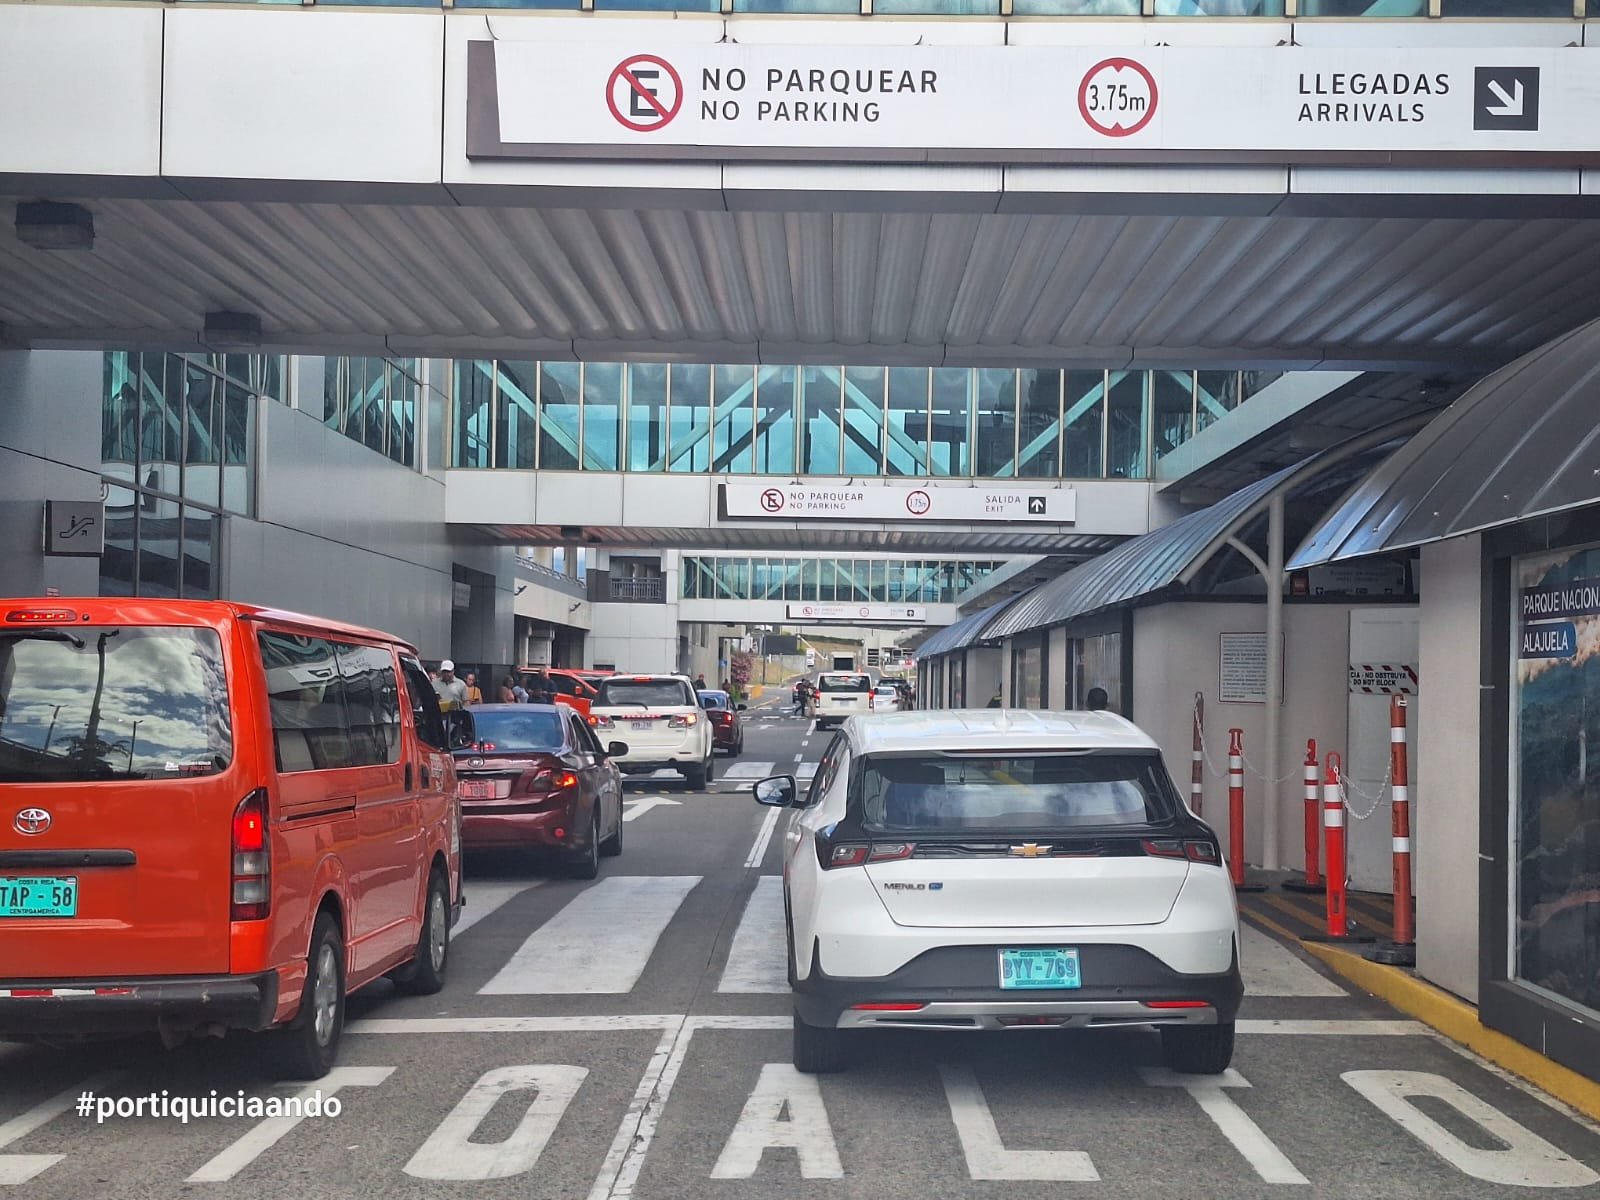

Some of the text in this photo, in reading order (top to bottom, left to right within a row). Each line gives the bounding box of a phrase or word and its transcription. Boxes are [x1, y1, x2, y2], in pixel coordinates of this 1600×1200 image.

[702, 68, 938, 95] NO PARQUEAR
[1299, 73, 1450, 95] LLEGADAS
[1088, 83, 1146, 112] 3.75m
[701, 101, 881, 122] NO PARKING
[1298, 103, 1425, 122] ARRIVALS
[790, 492, 864, 501] NO PARQUEAR
[807, 502, 846, 510] PARKING
[985, 495, 1021, 504] SALIDA
[985, 505, 1003, 513] EXIT
[1523, 585, 1600, 615] PARQUE NACION
[1522, 630, 1569, 653] ALAJUELA
[1376, 679, 1396, 687] BLOCK
[884, 882, 926, 890] MENLO
[52, 886, 73, 907] 58
